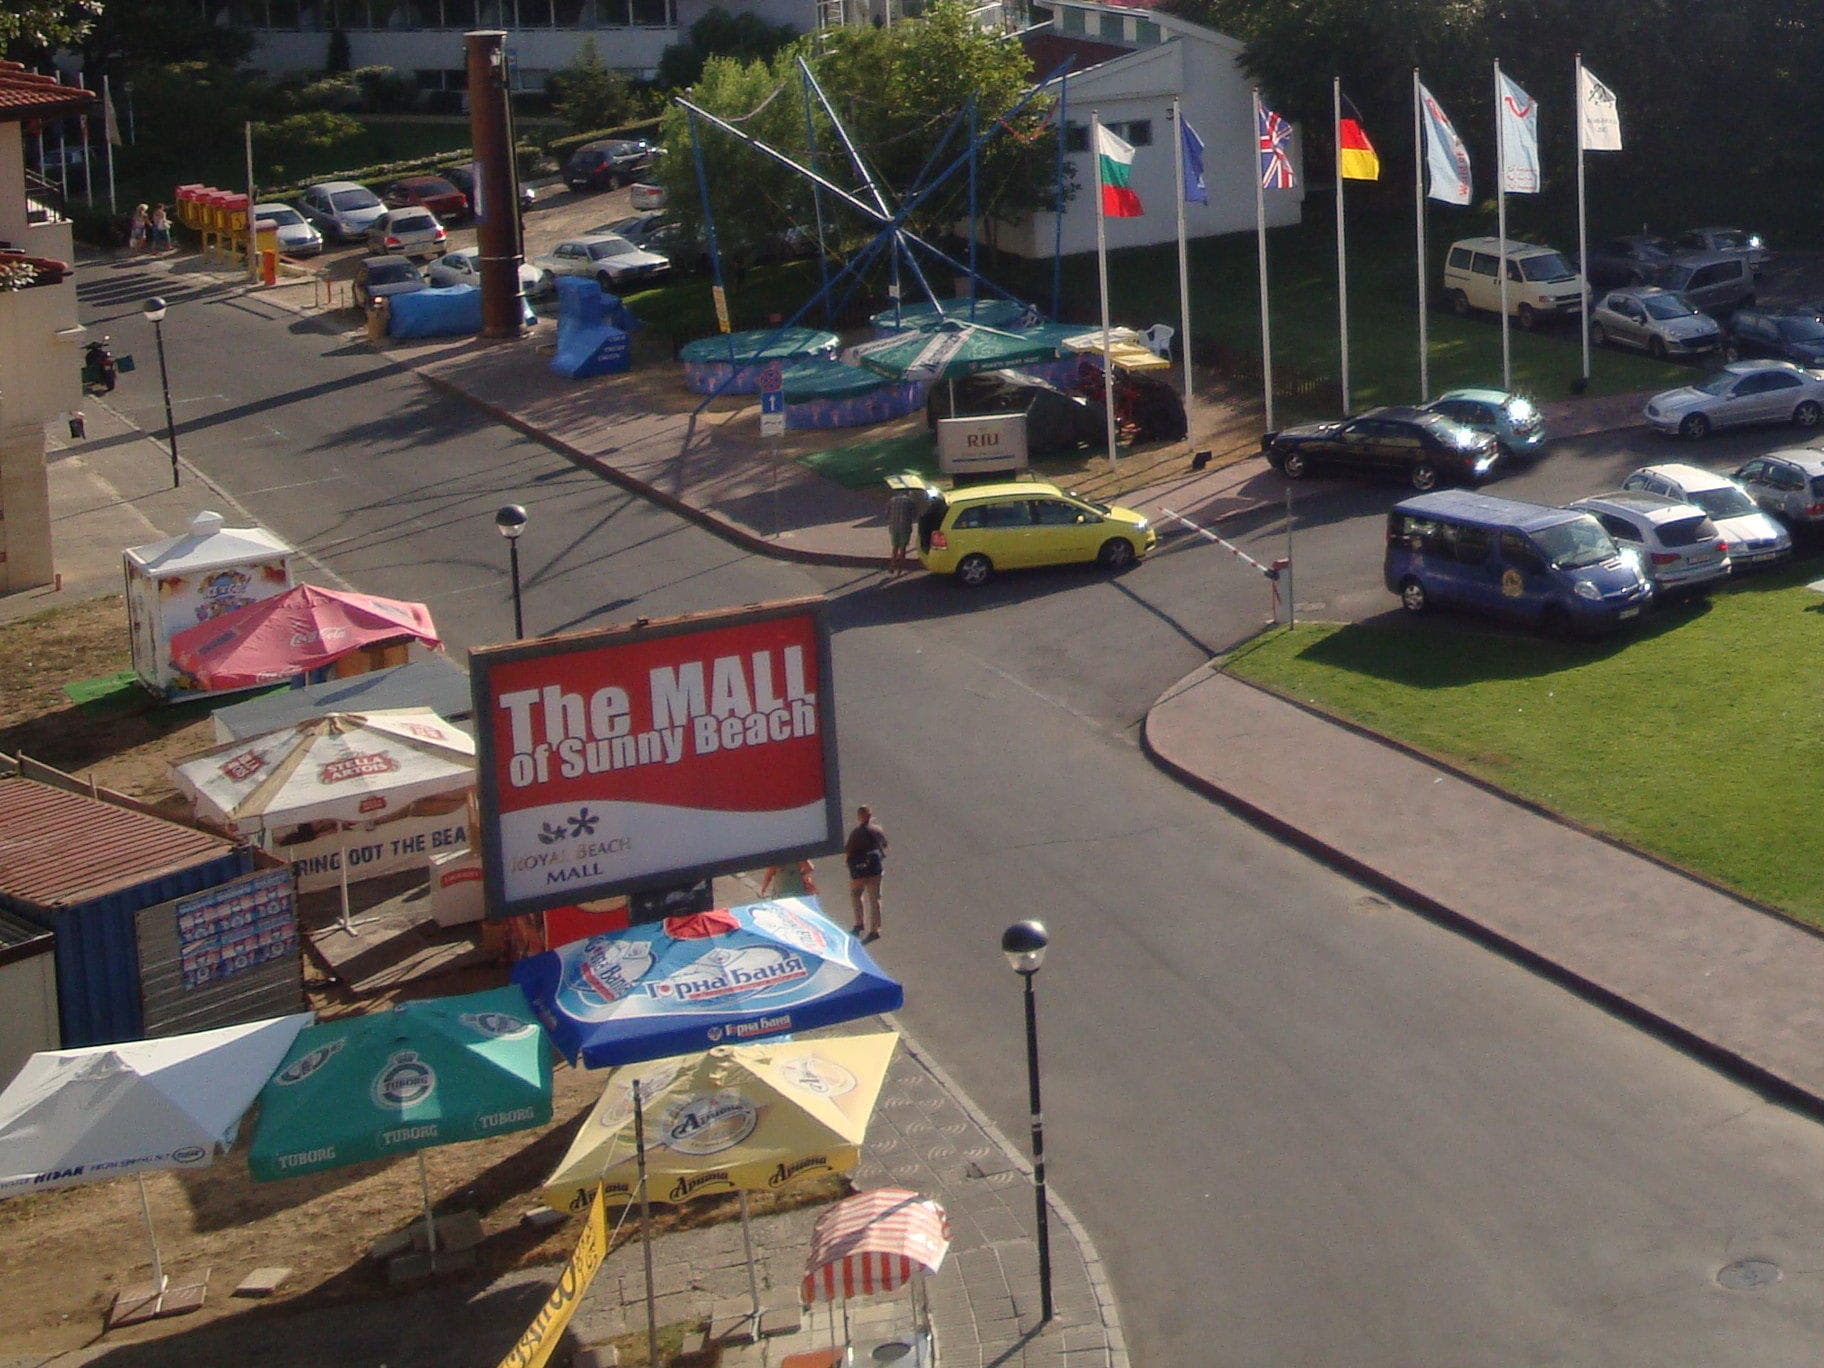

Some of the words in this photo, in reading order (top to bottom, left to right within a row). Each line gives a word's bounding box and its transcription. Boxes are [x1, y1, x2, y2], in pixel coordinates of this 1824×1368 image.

[966, 433, 999, 448] RIU
[500, 684, 632, 754] The
[650, 645, 816, 730] MALL
[509, 742, 551, 789] of
[558, 724, 685, 779] Sunny
[693, 701, 816, 755] Beach
[325, 754, 386, 773] STELLA
[391, 835, 425, 855] THE
[546, 862, 603, 885] MALL
[731, 958, 805, 984] Баня
[480, 1107, 534, 1128] TUBORG
[383, 1125, 438, 1145] TUBORG
[277, 1146, 336, 1169] TUBORG
[568, 1183, 629, 1211] Арана
